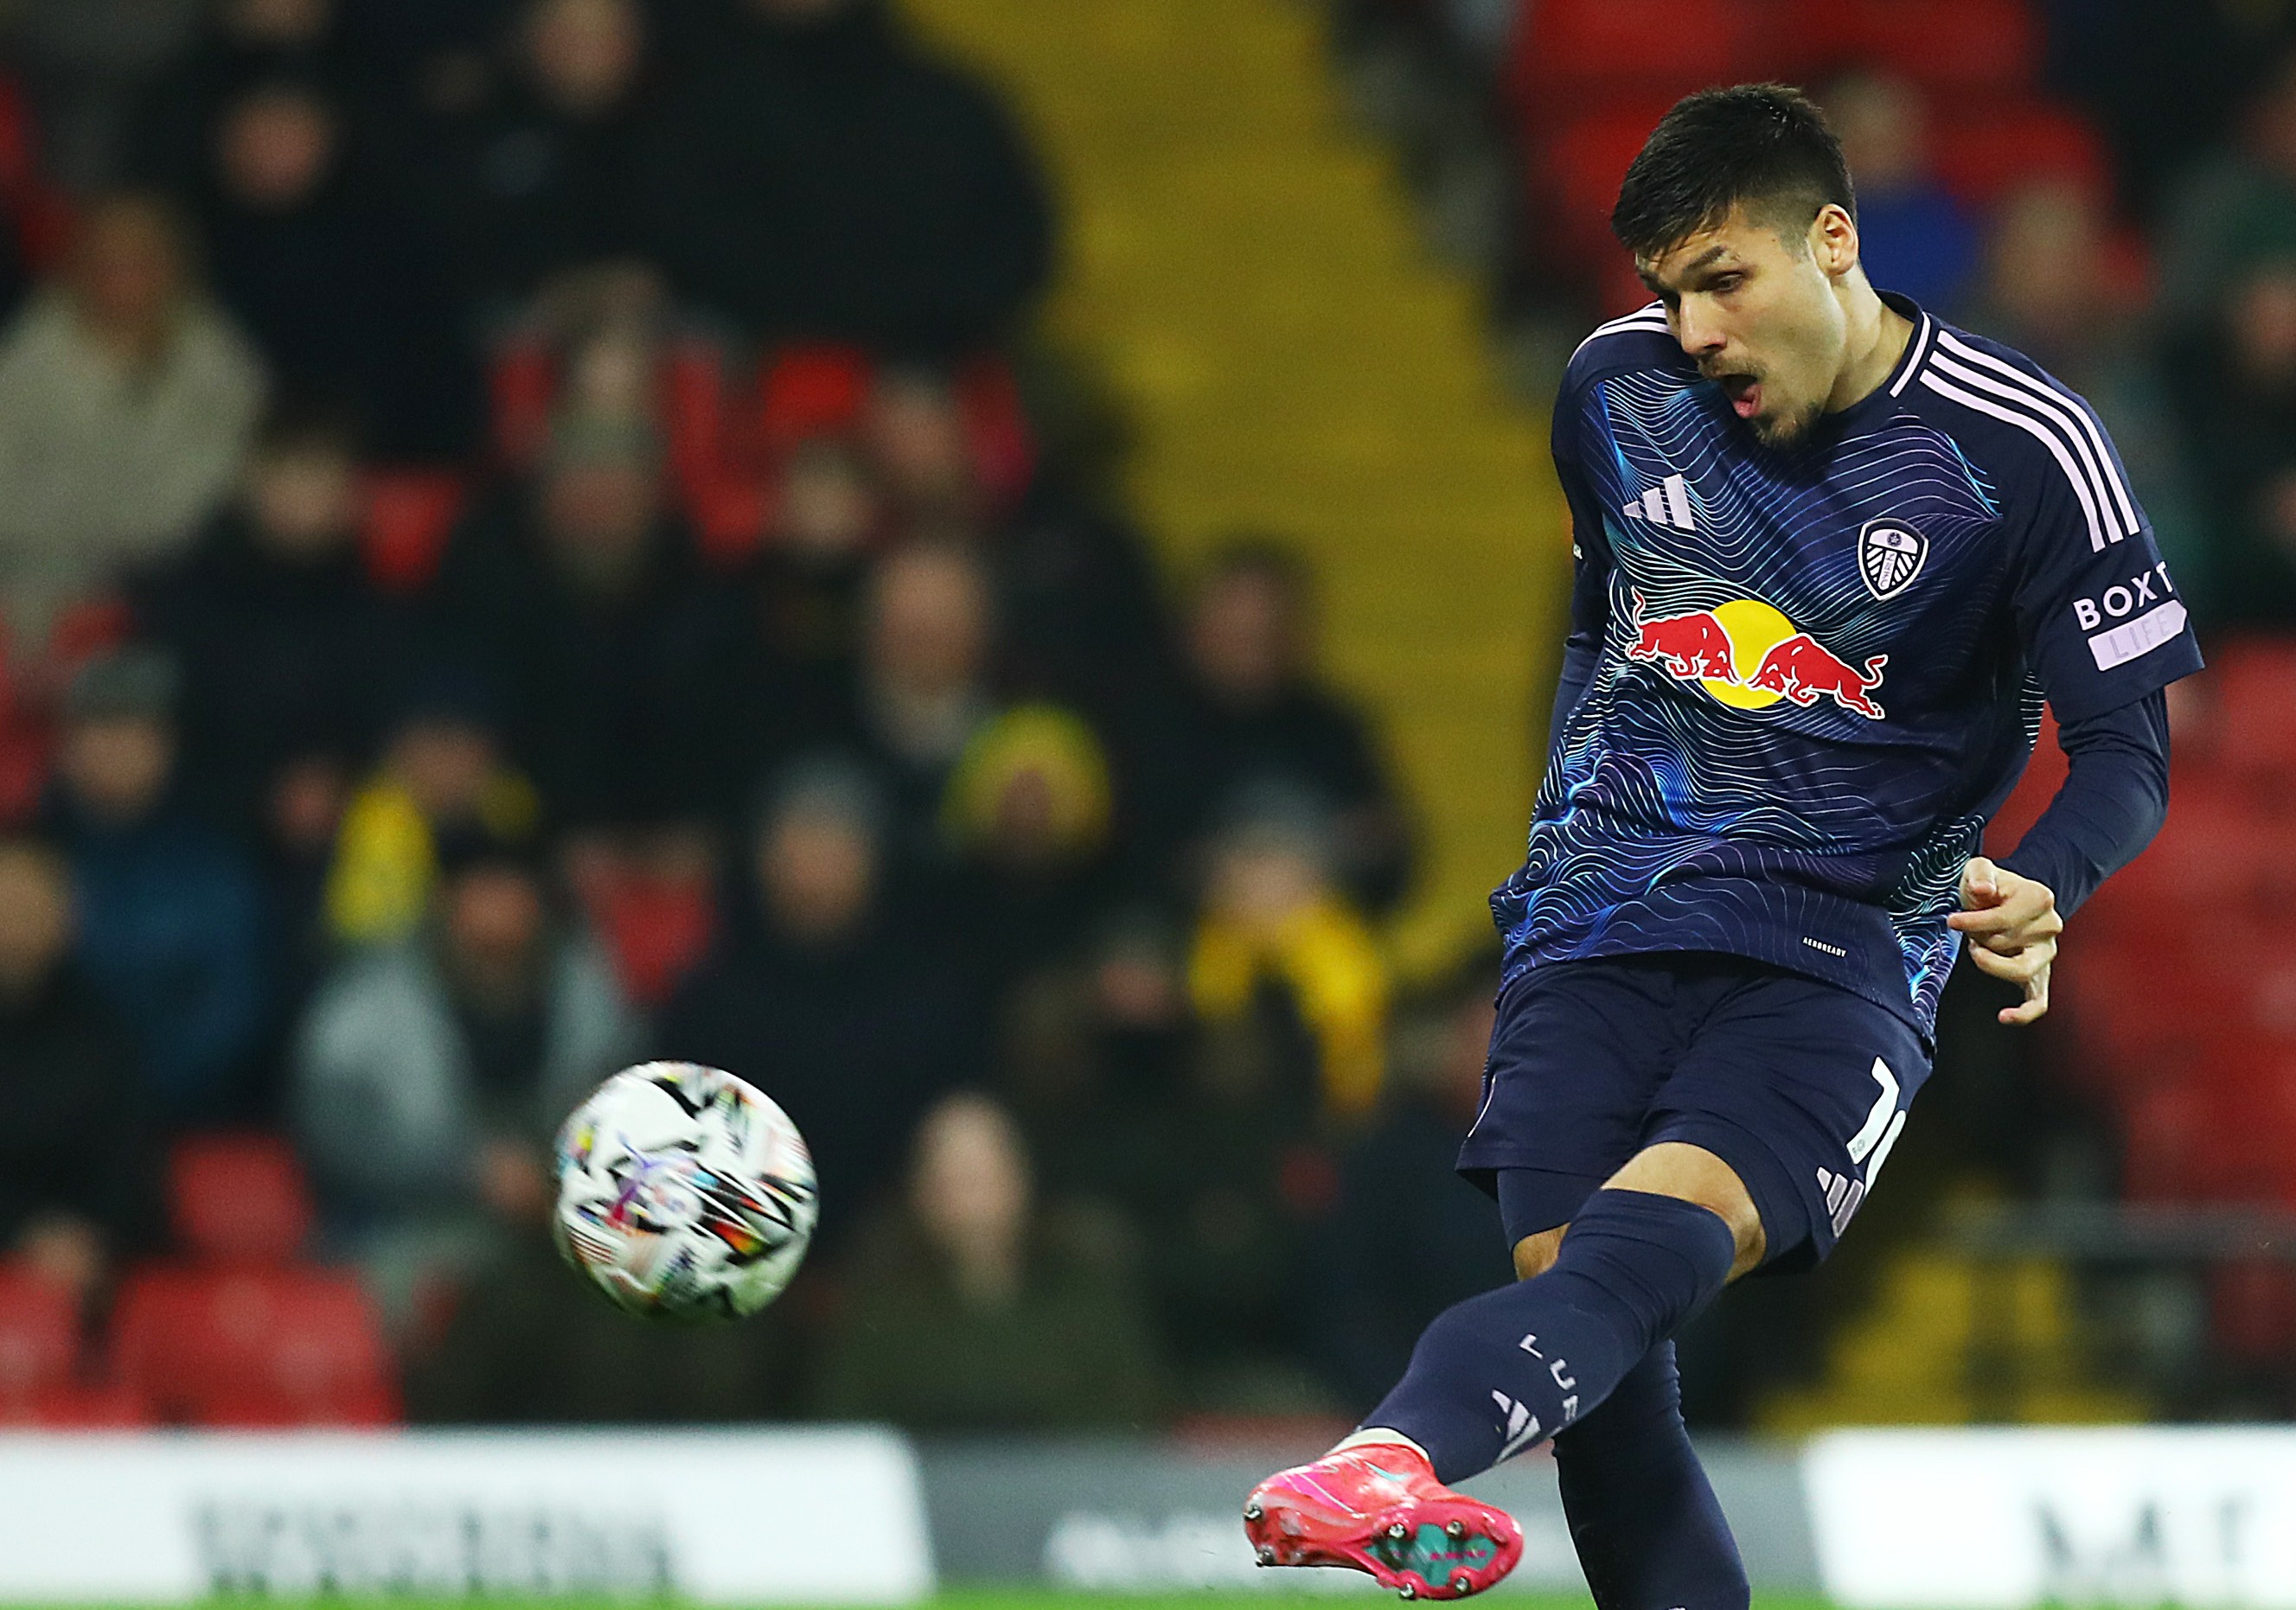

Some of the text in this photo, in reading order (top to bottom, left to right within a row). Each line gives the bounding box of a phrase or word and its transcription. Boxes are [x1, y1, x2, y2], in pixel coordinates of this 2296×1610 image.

[2073, 560, 2173, 631] BOXT
[2107, 609, 2172, 660] LIFE
[1802, 936, 1847, 958] AEROREADY
